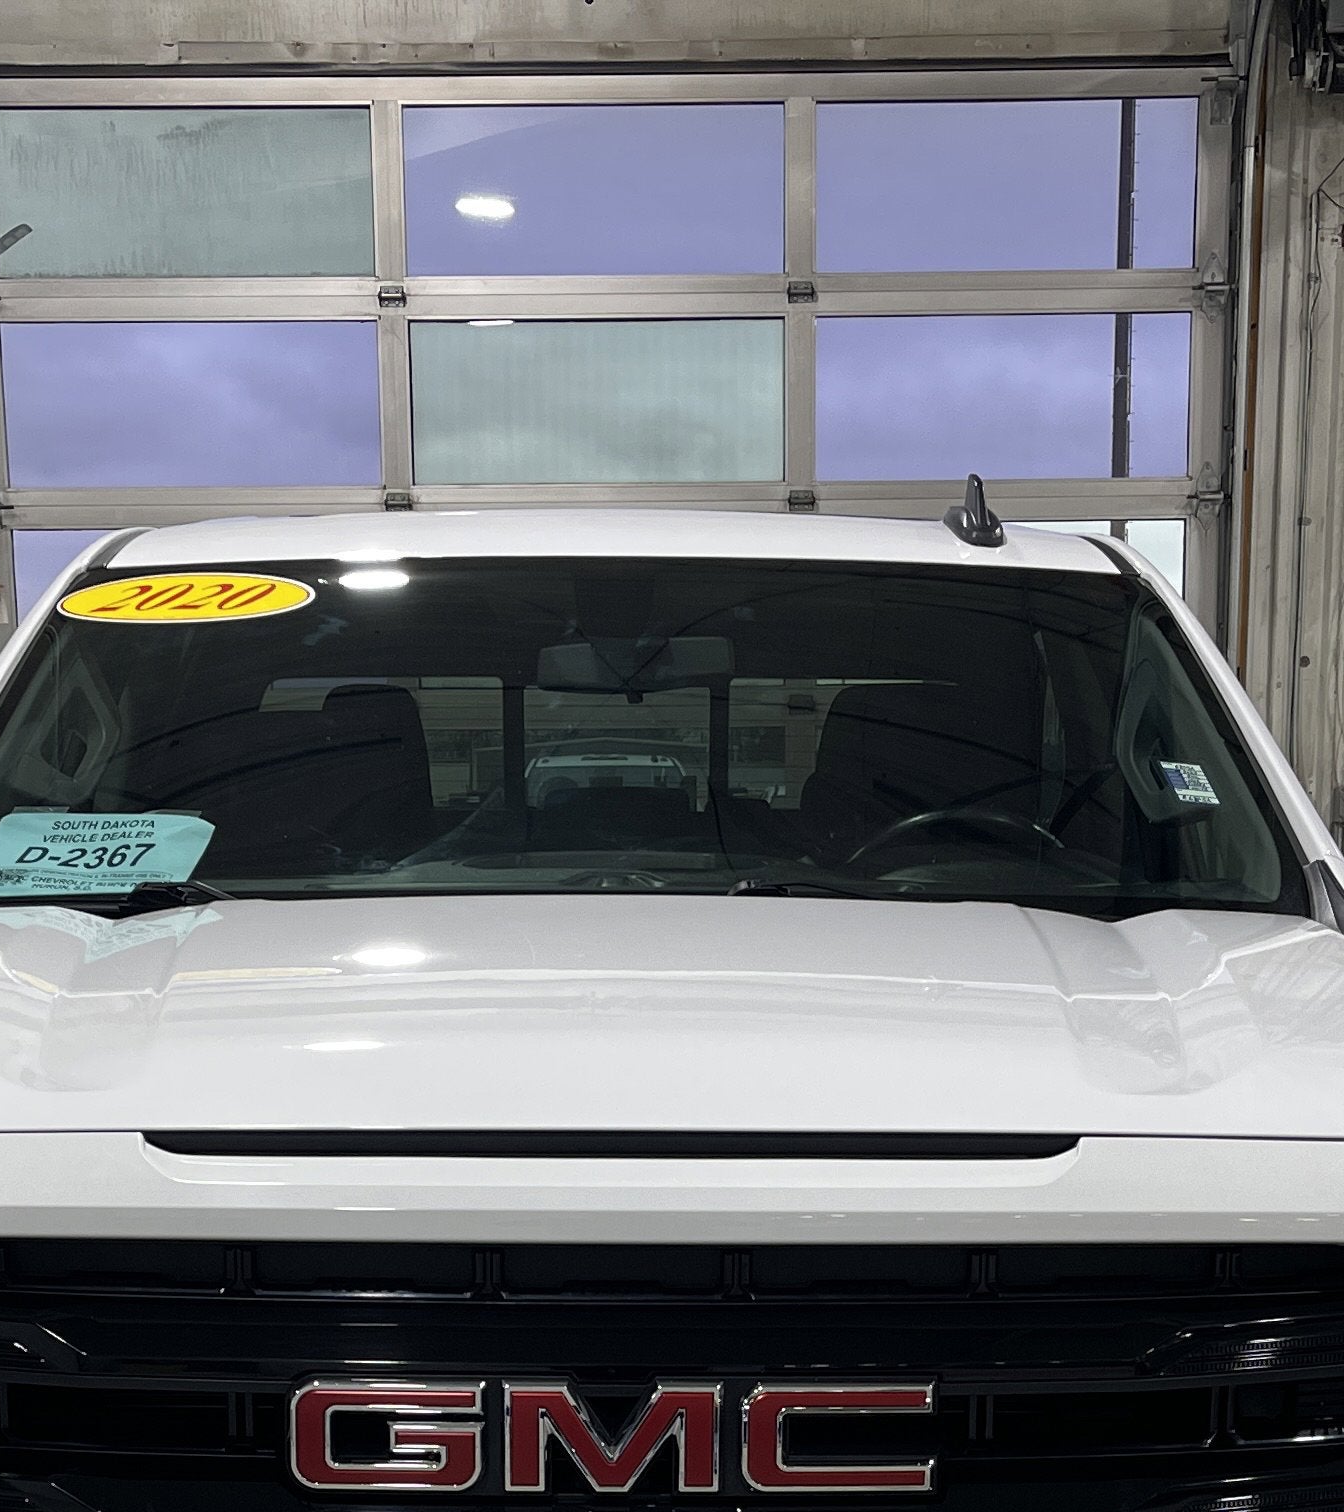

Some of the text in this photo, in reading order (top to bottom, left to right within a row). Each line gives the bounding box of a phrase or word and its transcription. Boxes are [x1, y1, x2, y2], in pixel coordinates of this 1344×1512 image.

[90, 583, 276, 612] 2020
[51, 820, 156, 831] SOUTH DAKOTA
[43, 831, 155, 844] VEHICLE DEALER
[15, 843, 156, 869] D-2367
[31, 876, 94, 886] CHEVROLET
[290, 1378, 935, 1493] GMC
